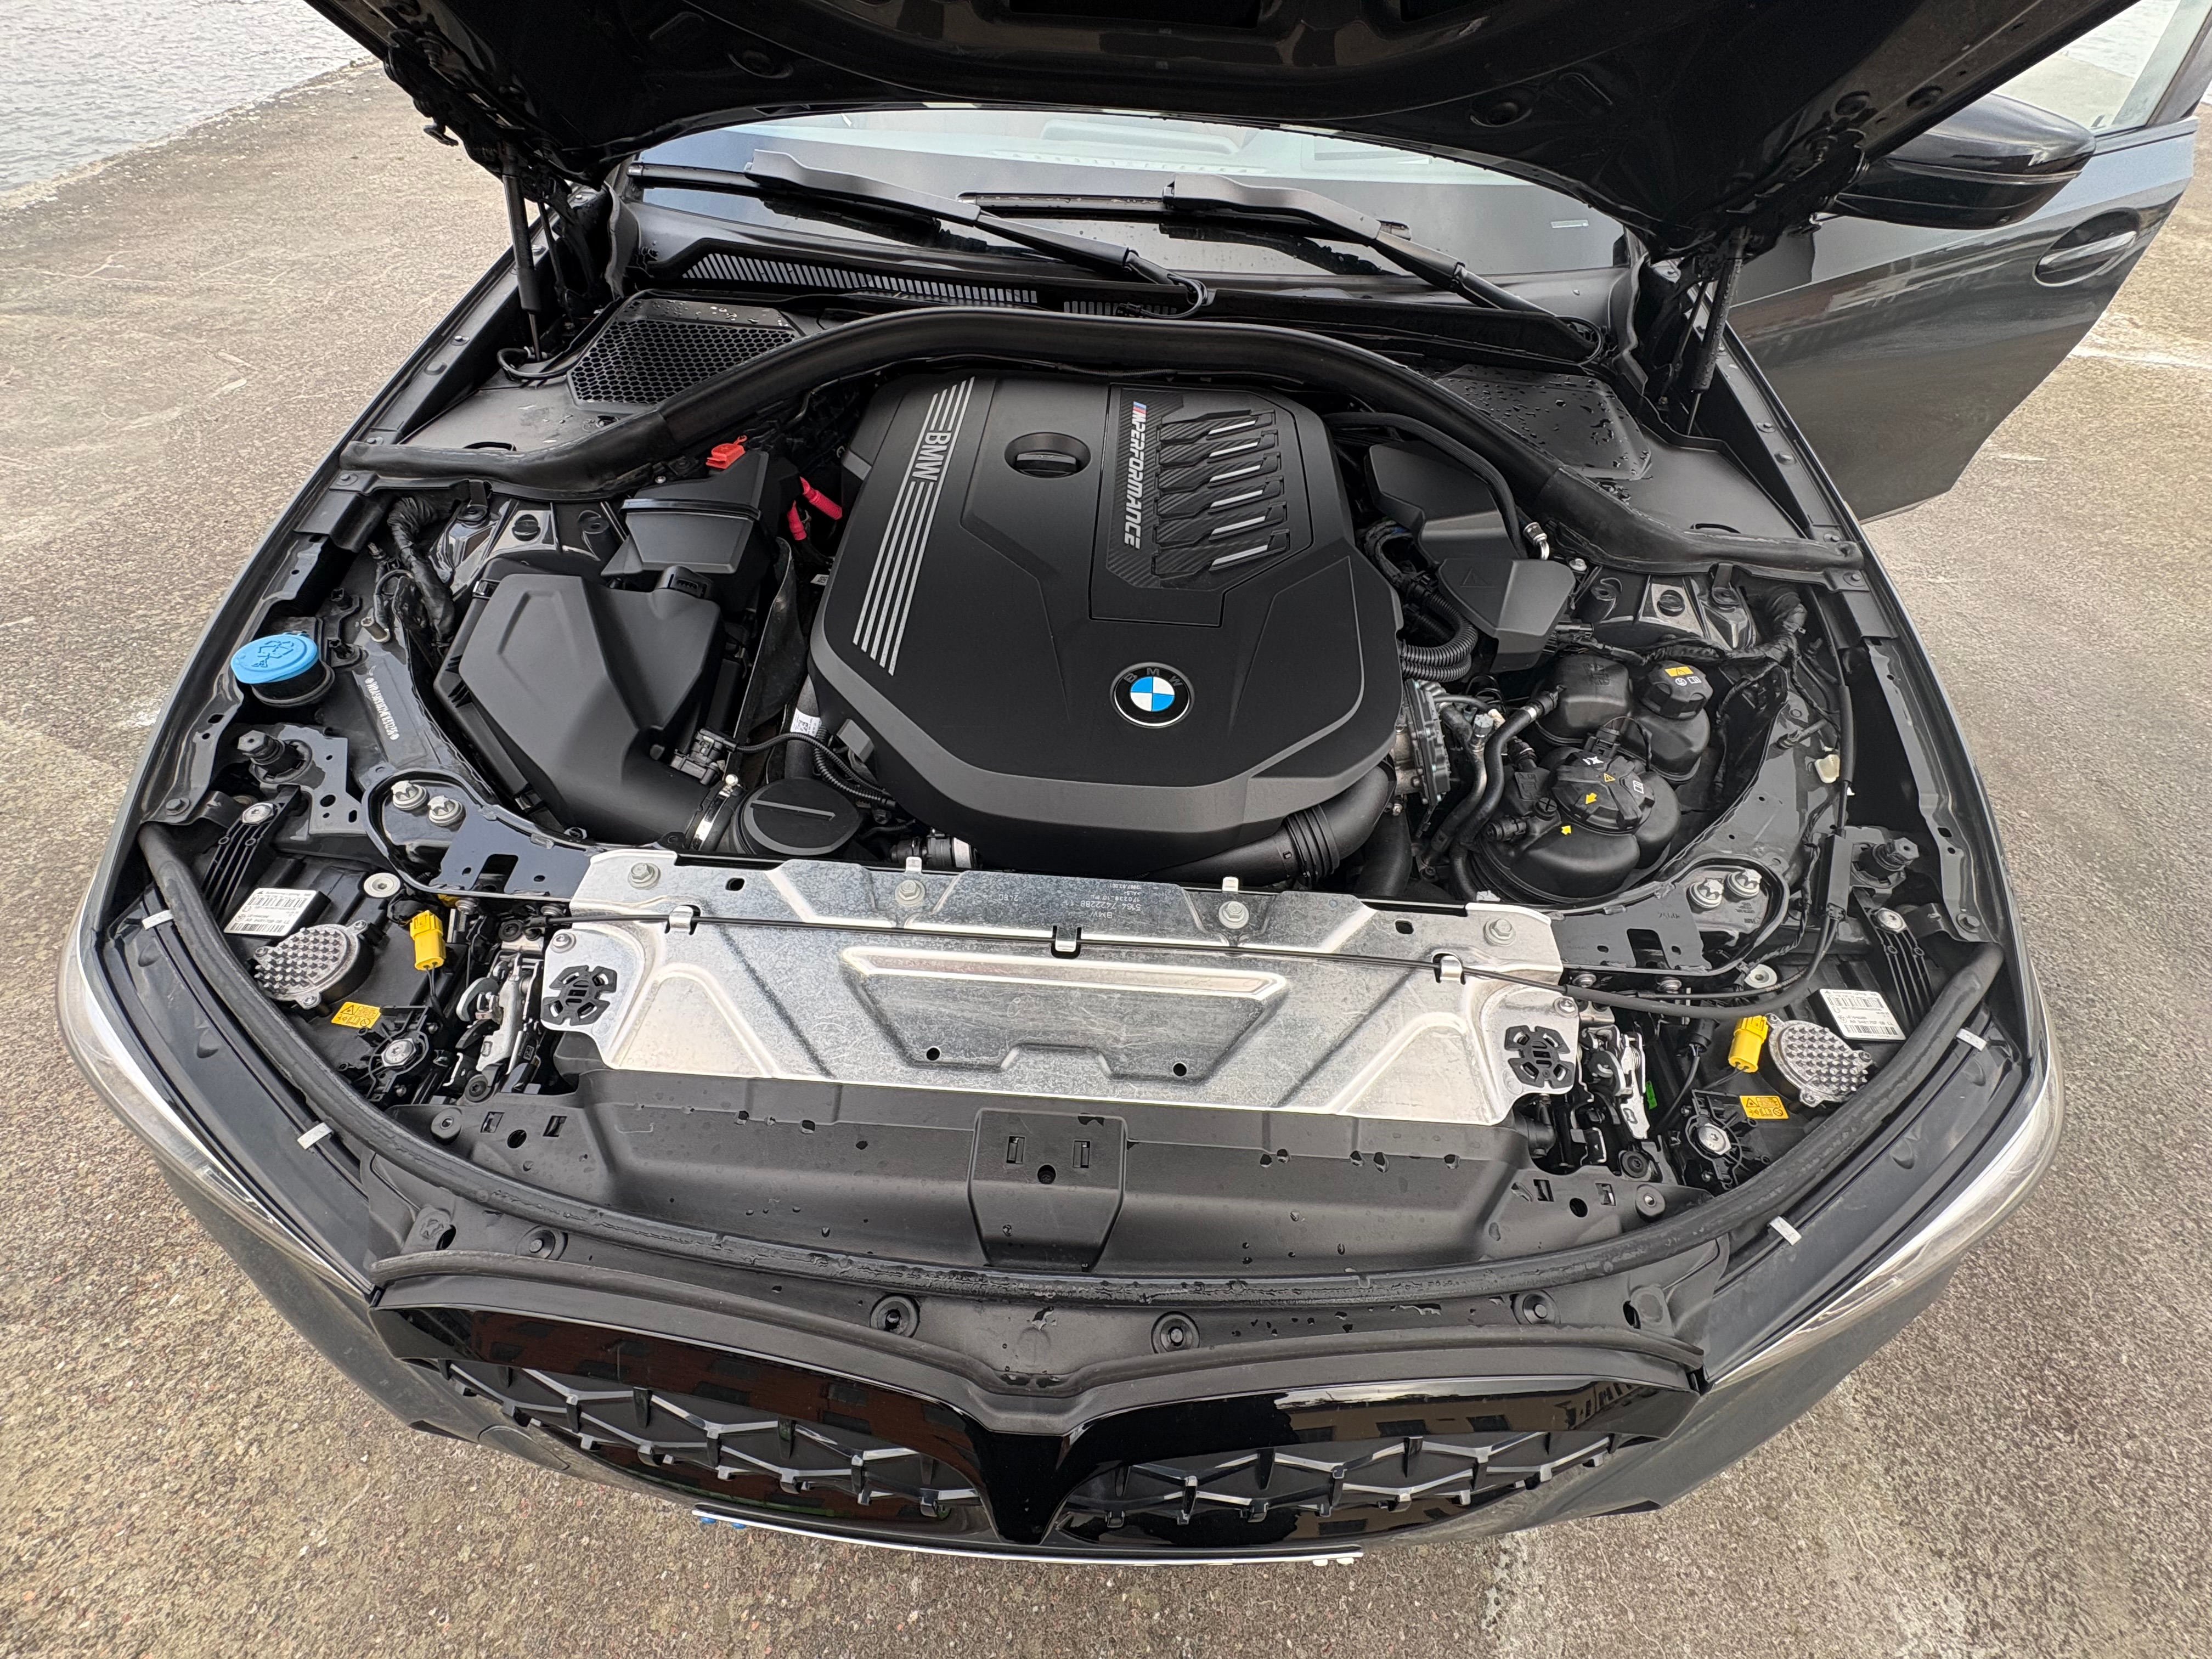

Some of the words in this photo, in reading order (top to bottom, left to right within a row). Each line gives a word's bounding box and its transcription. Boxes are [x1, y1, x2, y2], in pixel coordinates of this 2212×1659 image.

[912, 432, 952, 481] BMW
[1124, 668, 1183, 687] BMW
[1080, 900, 1117, 910] 7422288
[1121, 903, 1142, 911] 5164
